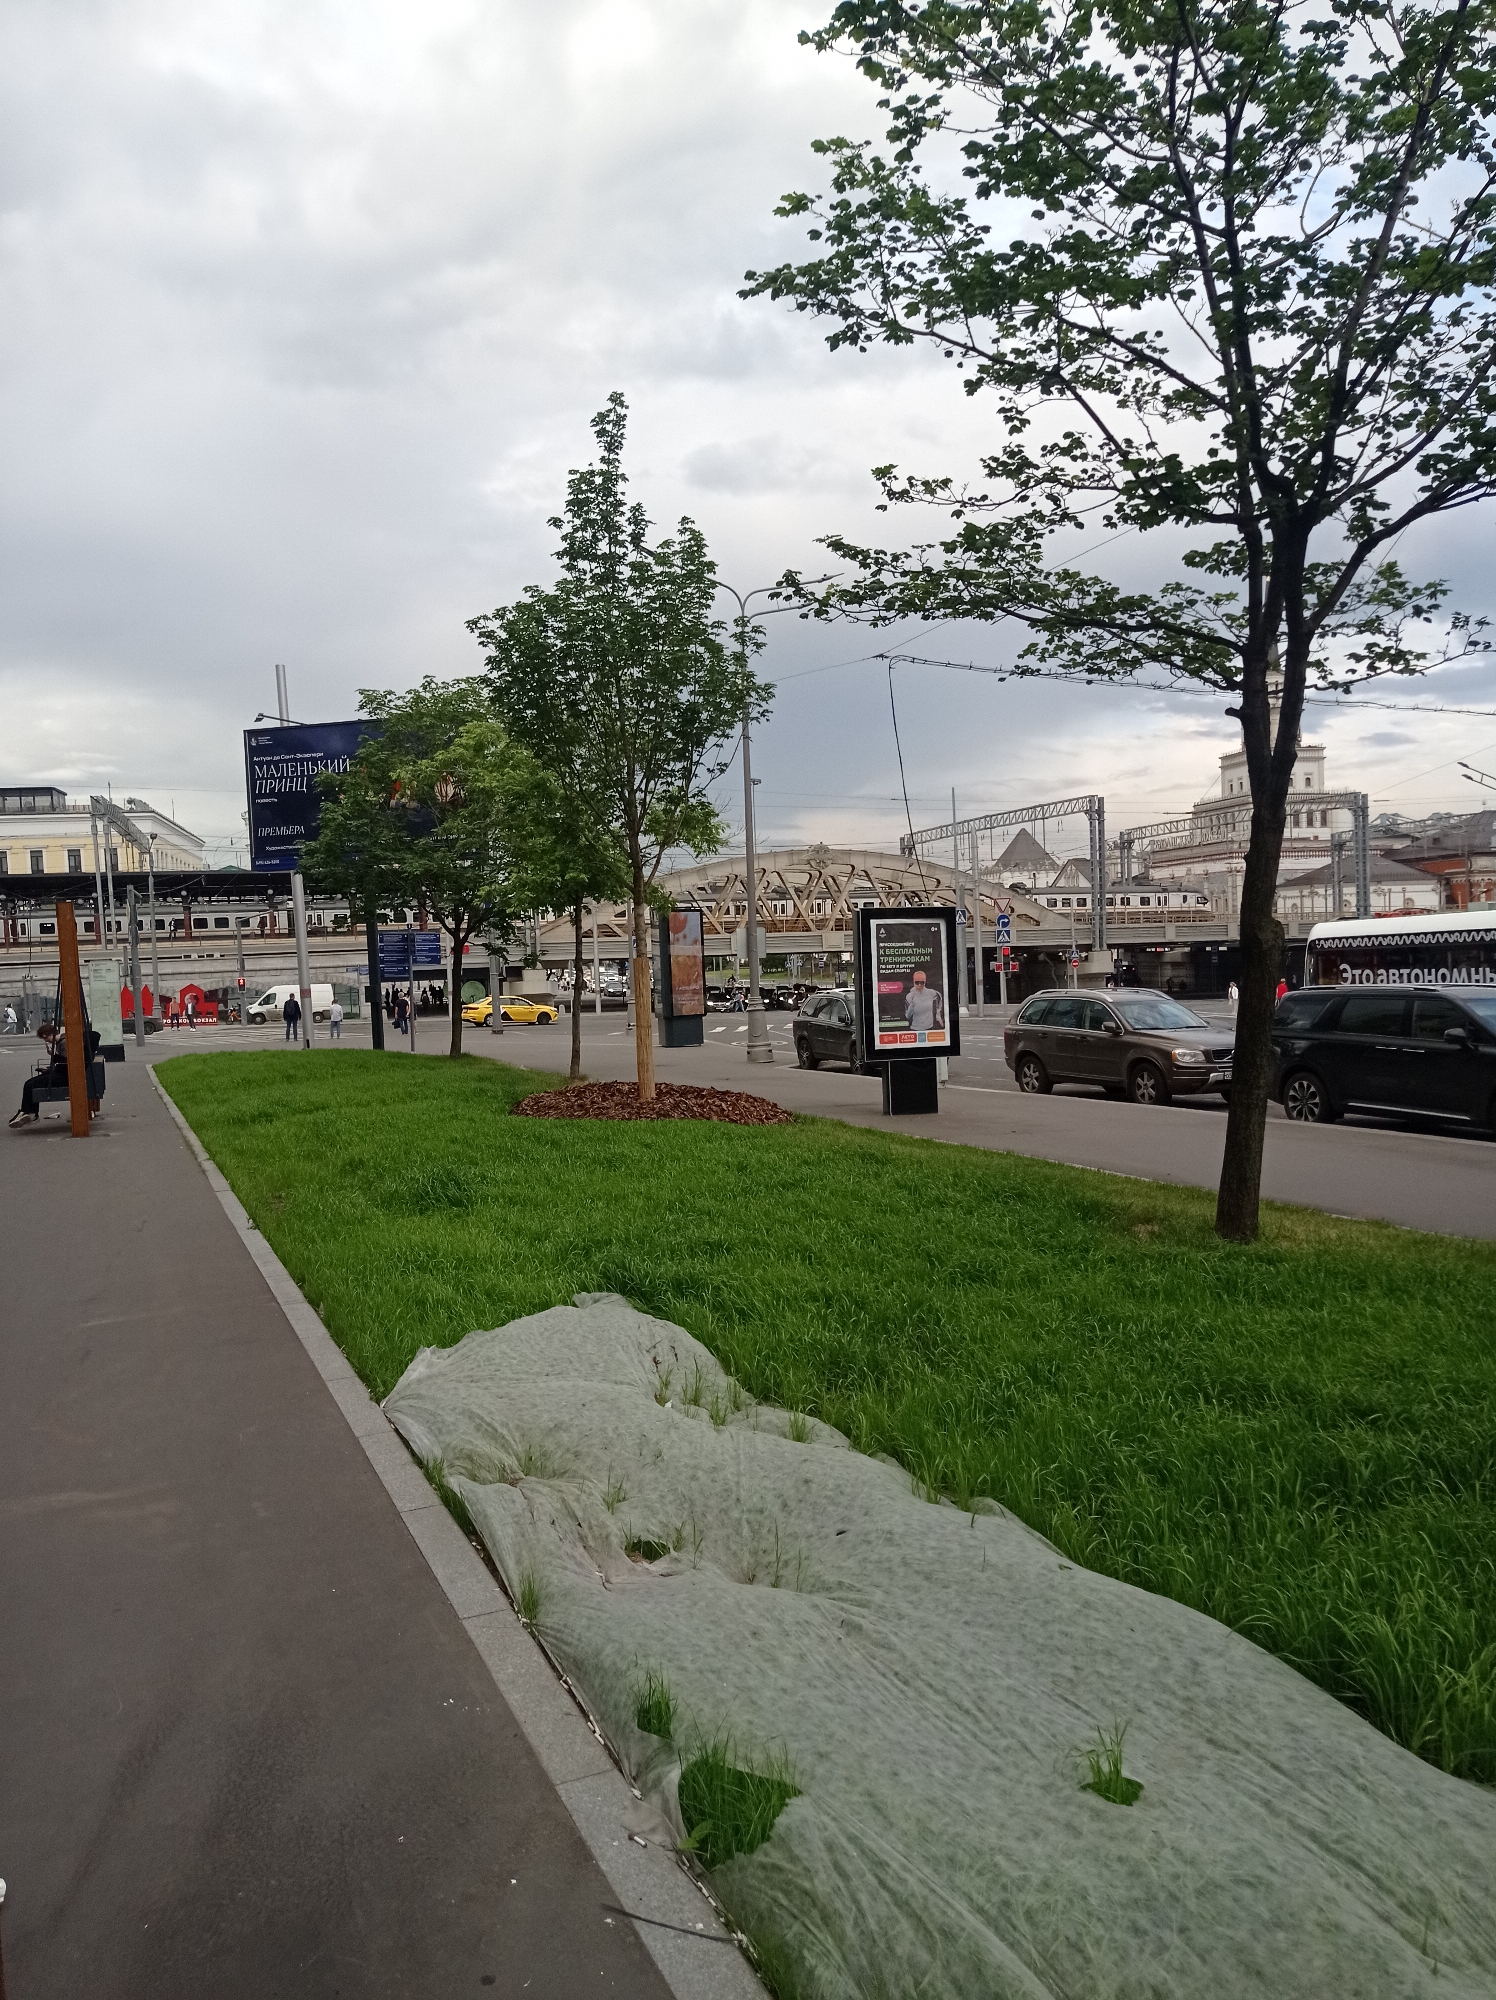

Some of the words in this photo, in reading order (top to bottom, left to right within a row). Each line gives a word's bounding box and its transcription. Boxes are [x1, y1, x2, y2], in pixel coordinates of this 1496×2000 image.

[254, 754, 350, 779] МАЛЕНЬКИЙ
[255, 777, 307, 794] ПРИНЦ
[258, 825, 305, 837] ПРЕМЬЕРА
[1339, 963, 1374, 985] Это
